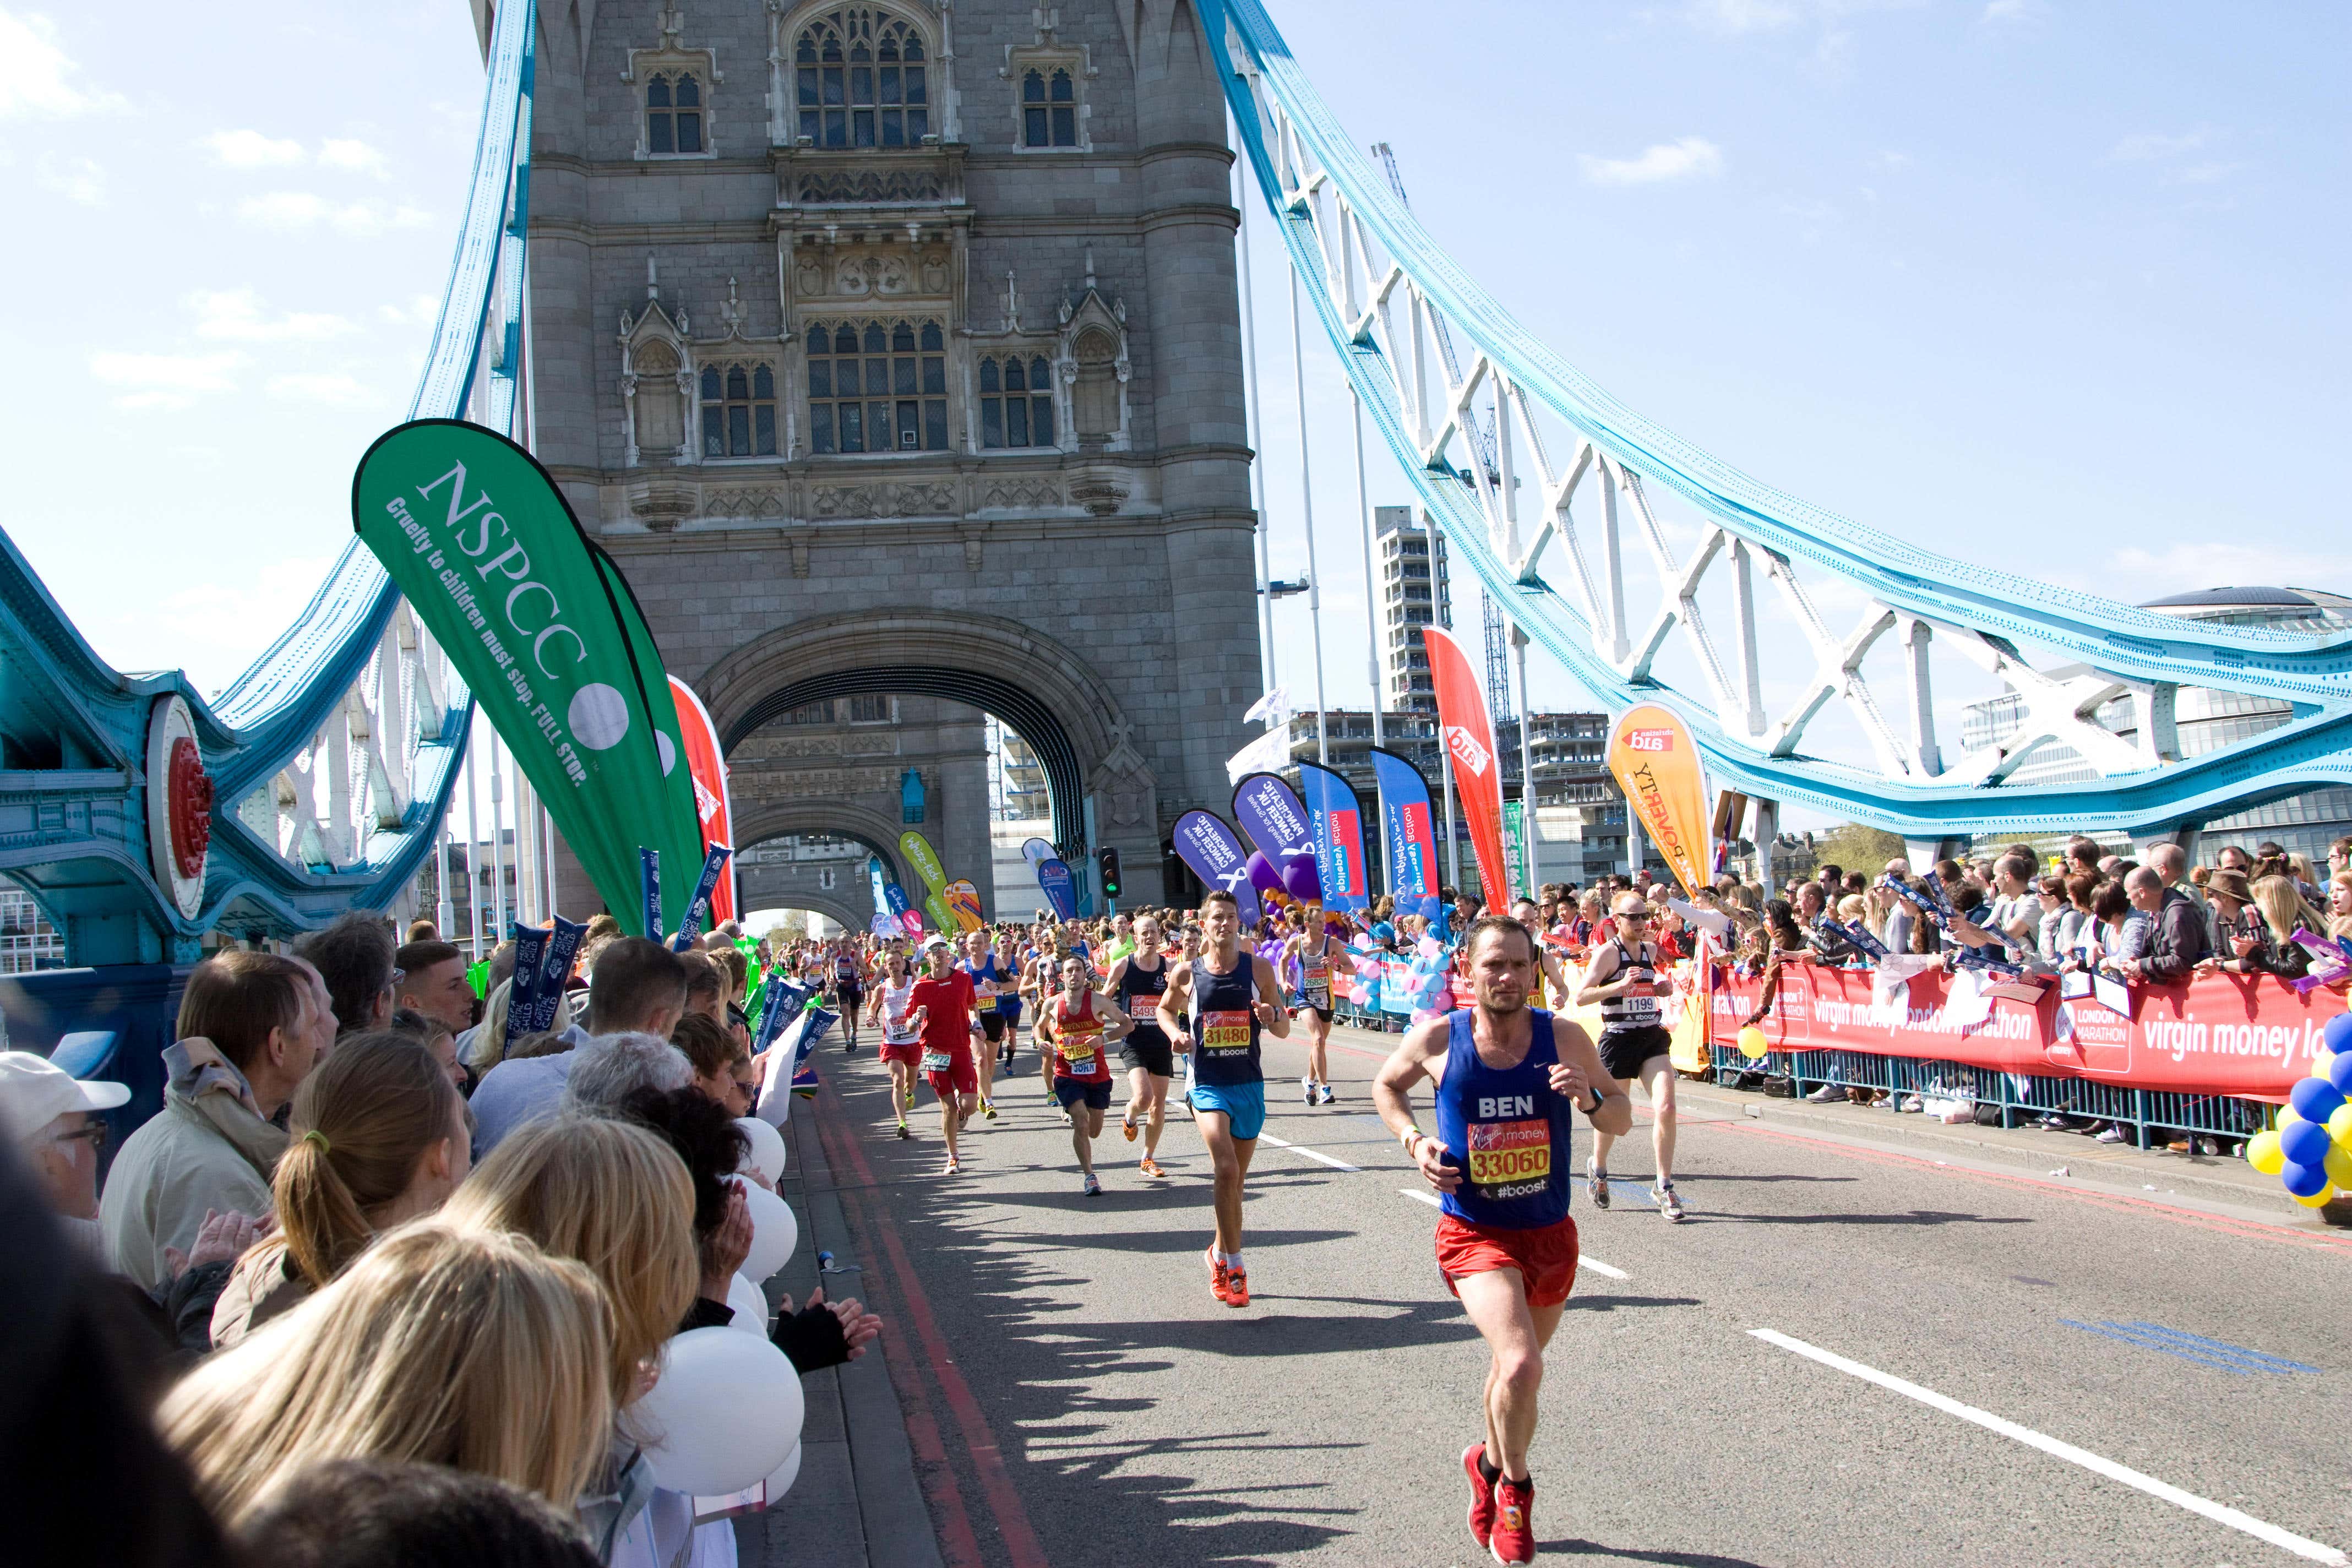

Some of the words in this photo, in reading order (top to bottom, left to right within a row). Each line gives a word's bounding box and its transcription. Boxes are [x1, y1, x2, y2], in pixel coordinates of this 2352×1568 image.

[416, 459, 587, 679] NSPCC
[386, 497, 433, 554] Cruelty
[427, 549, 445, 570] to
[439, 569, 486, 630] children
[480, 629, 515, 669] must
[507, 668, 533, 707] stop.
[530, 703, 562, 745] FULL
[557, 743, 587, 787] STOP.
[680, 919, 690, 940] CHILD
[685, 922, 695, 941] CAPITAL
[523, 942, 532, 962] CAPITAL
[529, 941, 538, 963] CHILD
[554, 935, 562, 952] HELP
[559, 933, 570, 954] CAPITAL
[564, 933, 576, 956] CHILD
[1305, 977, 1327, 987] 26824
[978, 999, 996, 1008] 0777
[1627, 998, 1653, 1011] 1199
[1776, 991, 1798, 1003] LONDON
[507, 1008, 516, 1030] HELP
[513, 1004, 524, 1033] CAPITAL
[534, 995, 551, 1026] CAPITAL
[541, 997, 558, 1028] CHILD
[1133, 1007, 1156, 1017] 5493
[1206, 1014, 1222, 1027] Virgin
[1814, 994, 1850, 1032] virgin
[2078, 1009, 2115, 1023] LONDON
[819, 1021, 830, 1036] CHILD
[892, 1024, 906, 1033] 242
[1205, 1028, 1249, 1044] 31480
[2076, 1025, 2127, 1042] MARATHON
[2144, 1011, 2207, 1061] virgin
[2213, 1023, 2300, 1068] money
[1219, 1048, 1248, 1057] #boost
[2052, 1046, 2073, 1058] money
[1074, 1064, 1095, 1072] JOHN
[1479, 1095, 1533, 1118] BEN
[1473, 1128, 1502, 1150] Virgin
[1506, 1128, 1545, 1141] money
[1473, 1148, 1548, 1178] 33060
[1498, 1179, 1546, 1199] #boost
